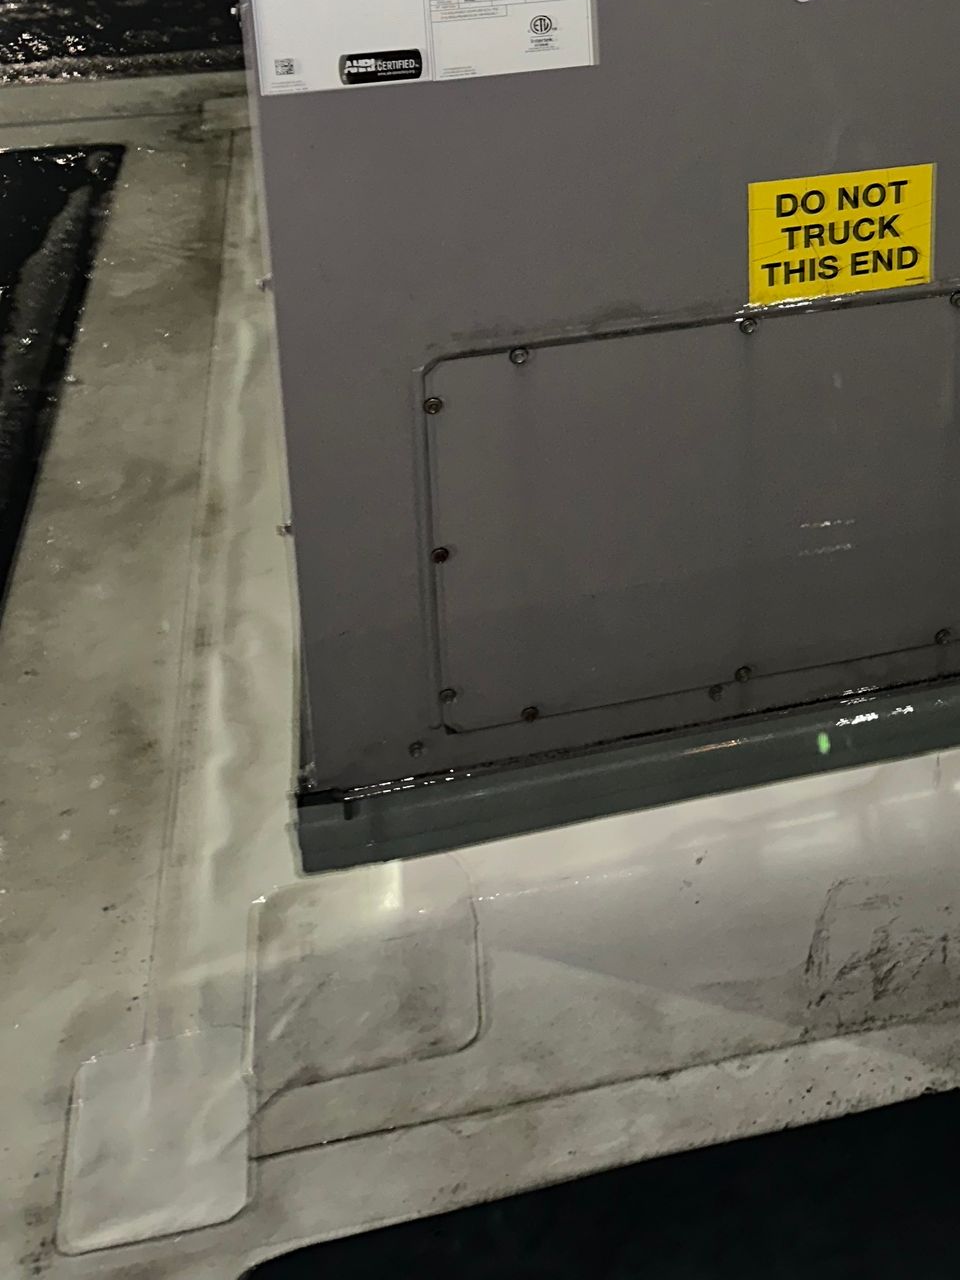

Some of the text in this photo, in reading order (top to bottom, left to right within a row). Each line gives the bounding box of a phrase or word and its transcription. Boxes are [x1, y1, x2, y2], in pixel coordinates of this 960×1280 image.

[344, 58, 375, 73] AHRI
[377, 59, 415, 70] CERTIFIED
[776, 180, 908, 218] DO NOT
[782, 214, 900, 250] TRUCK
[762, 246, 920, 286] THIS END
